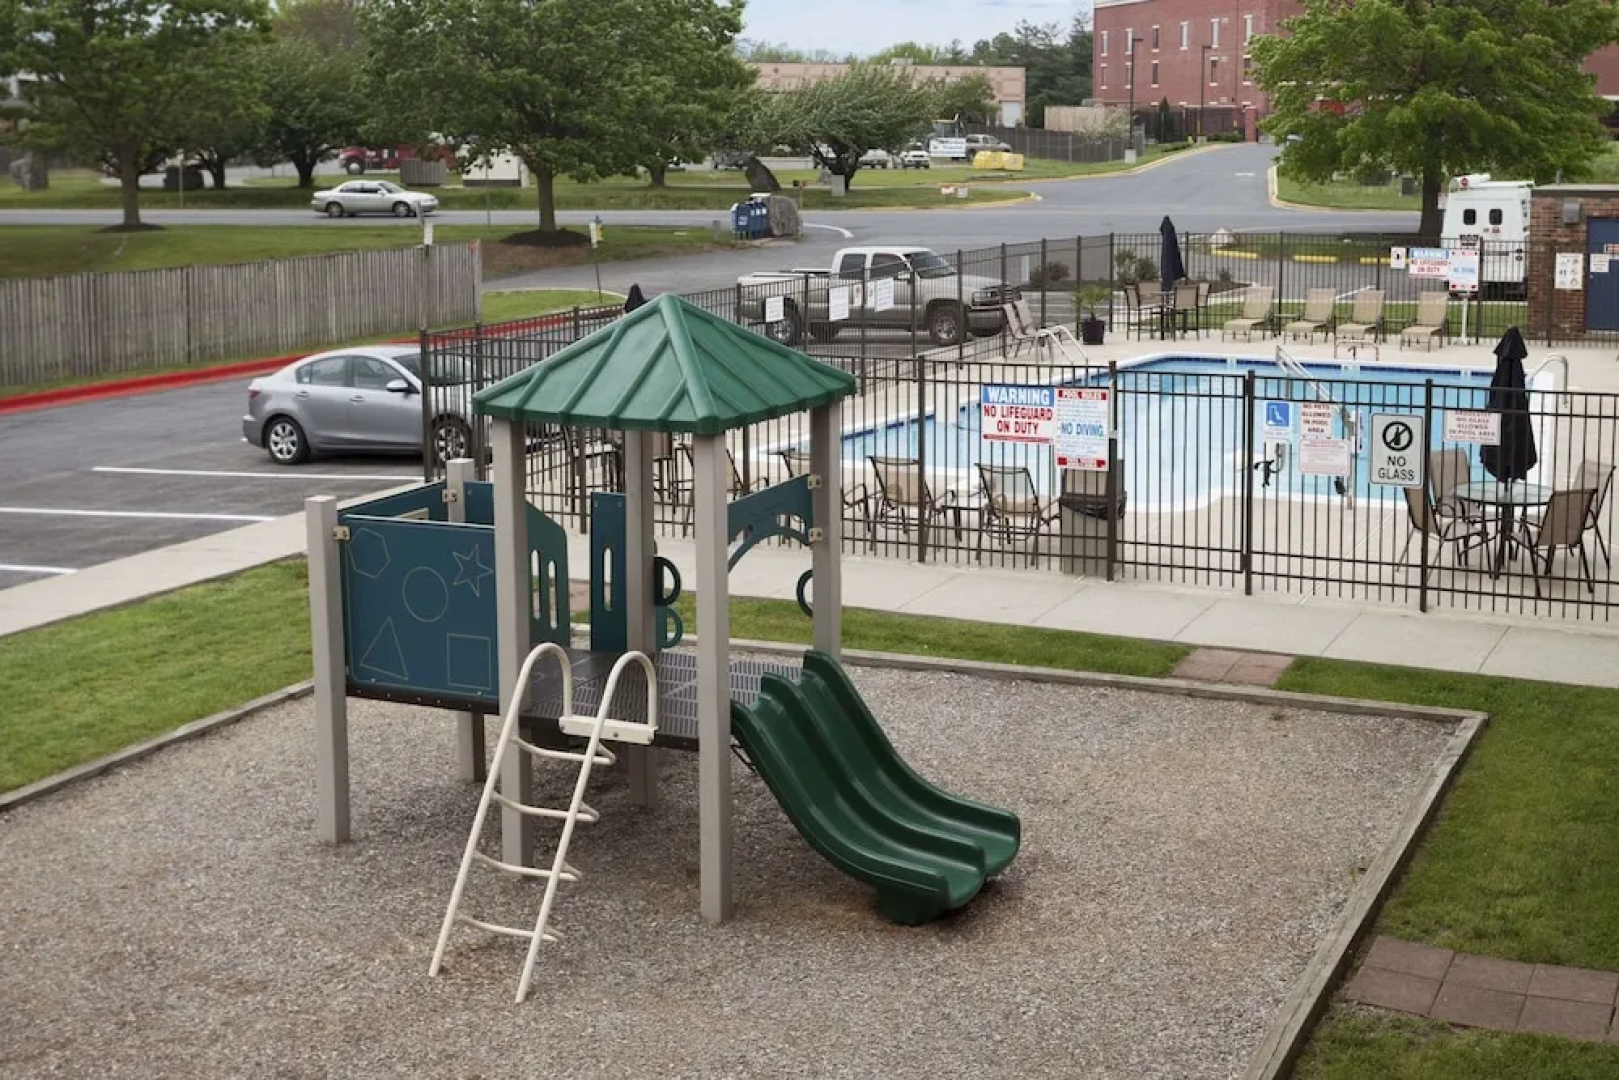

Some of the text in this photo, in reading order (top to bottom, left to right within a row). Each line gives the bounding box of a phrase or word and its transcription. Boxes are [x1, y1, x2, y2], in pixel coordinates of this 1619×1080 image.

[987, 387, 1050, 405] WARNING
[983, 405, 996, 417] NO
[1001, 406, 1053, 421] LIFEGUARD
[997, 420, 1039, 434] ON DUTY
[1061, 422, 1104, 437] NO DIVING
[1387, 456, 1407, 467] NO
[1378, 468, 1414, 480] GLASS
